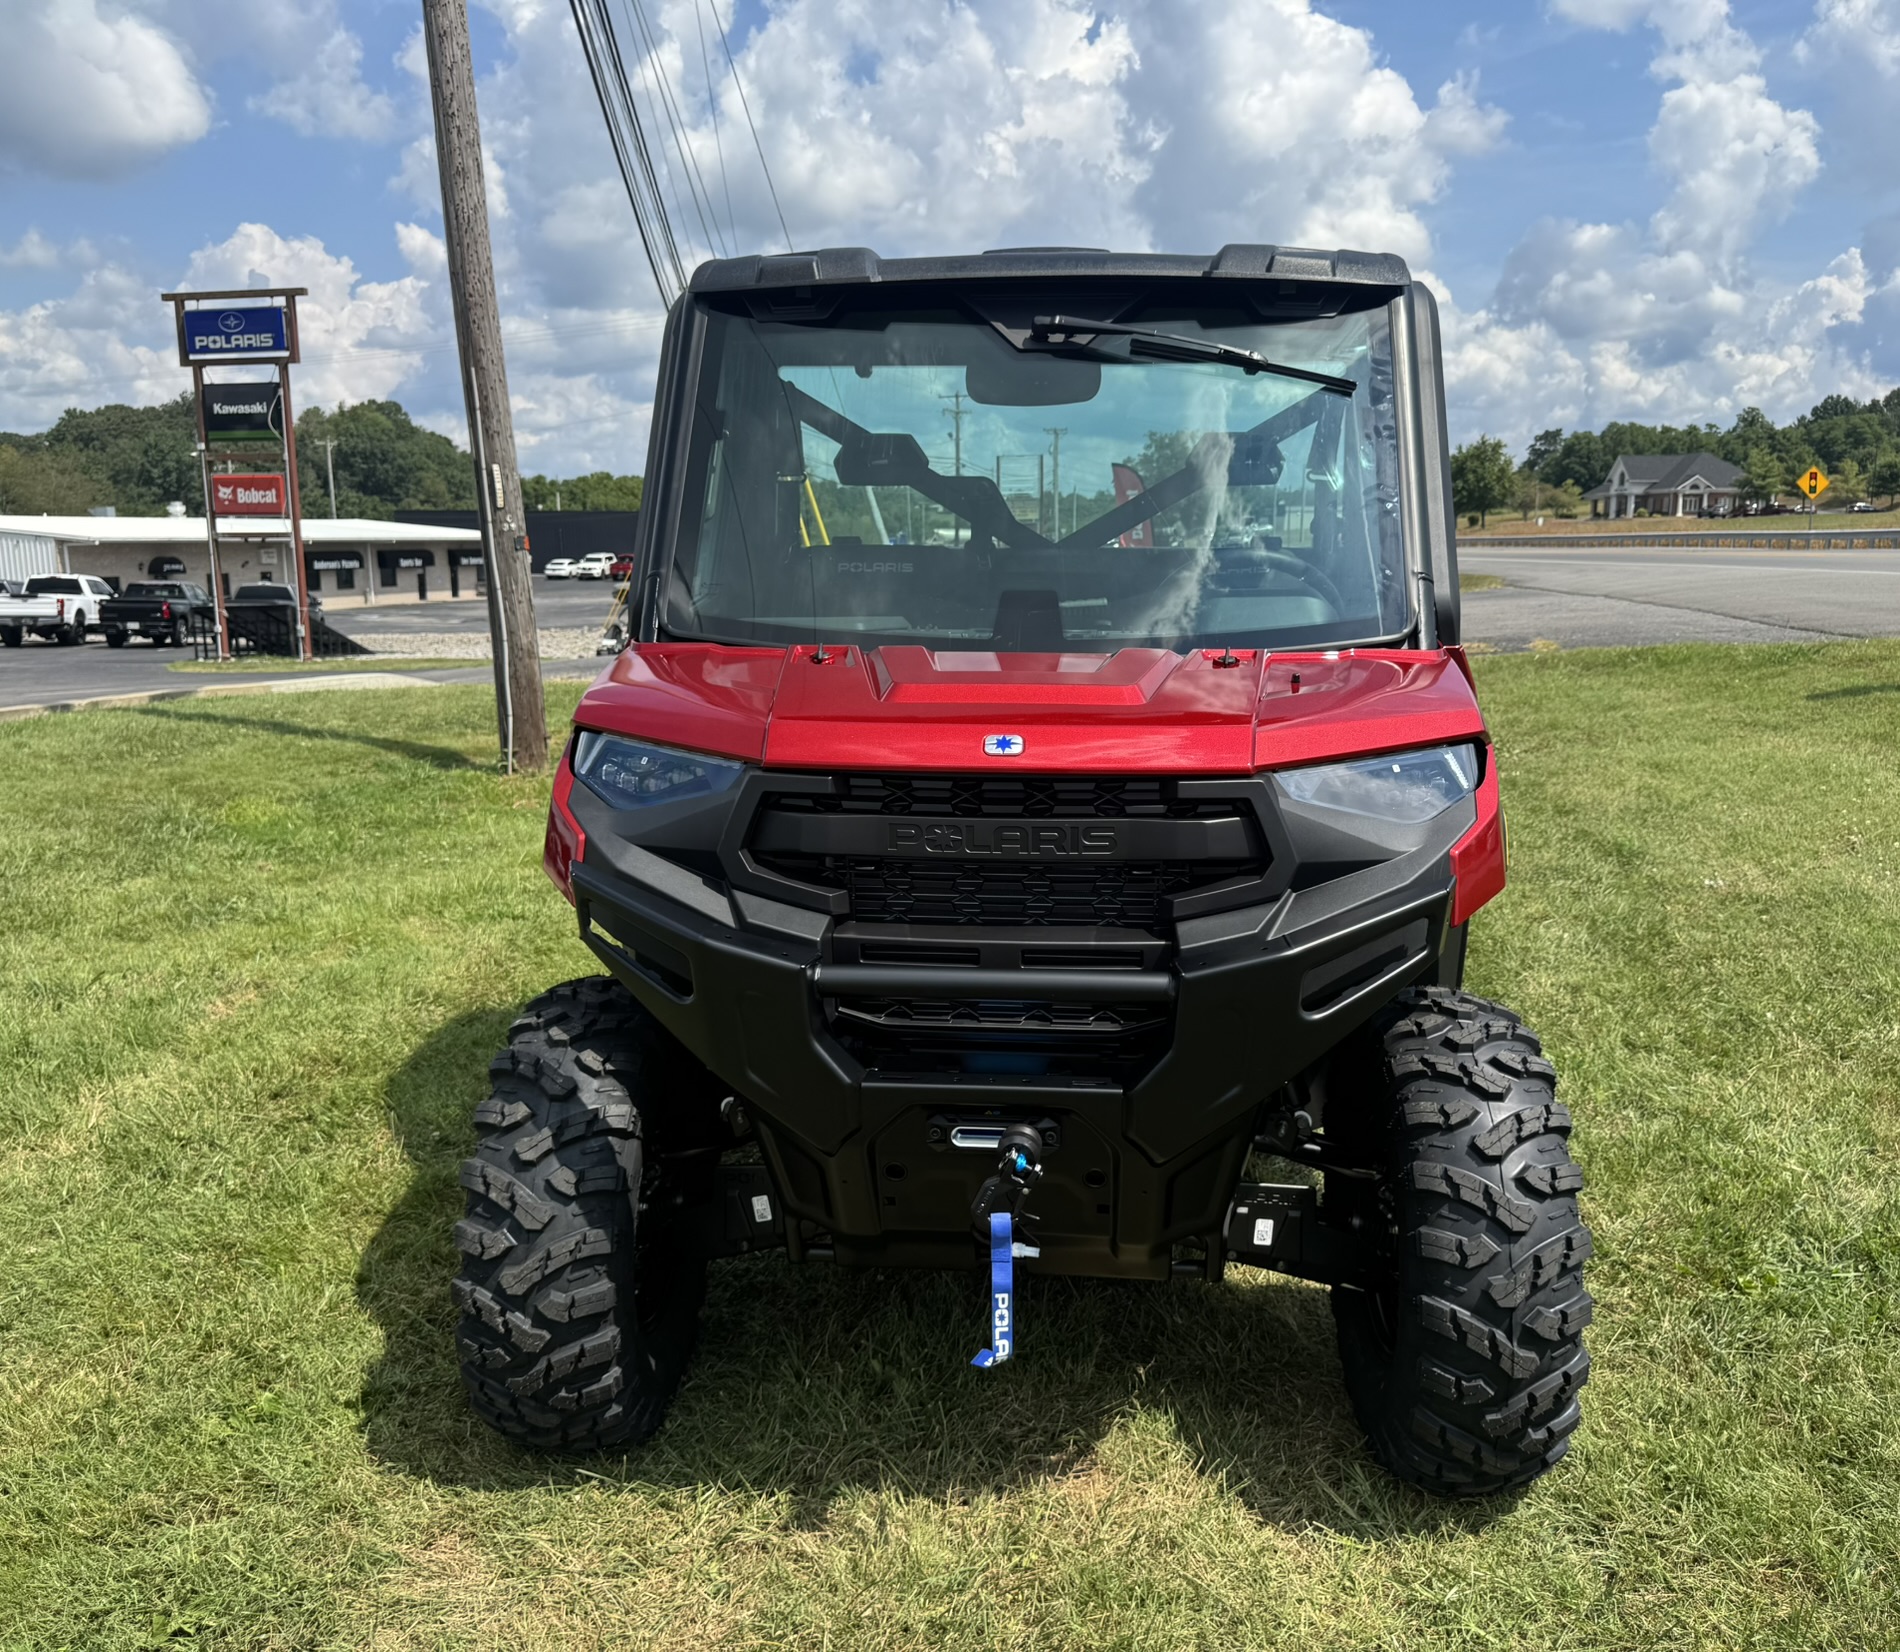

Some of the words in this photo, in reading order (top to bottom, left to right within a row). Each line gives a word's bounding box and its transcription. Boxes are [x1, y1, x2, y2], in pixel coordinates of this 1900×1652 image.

[194, 333, 274, 350] POLARIS
[213, 402, 267, 415] Kawasaki
[236, 487, 277, 504] Bobcat
[837, 562, 914, 573] POLARIS
[887, 822, 1118, 856] POLARIS
